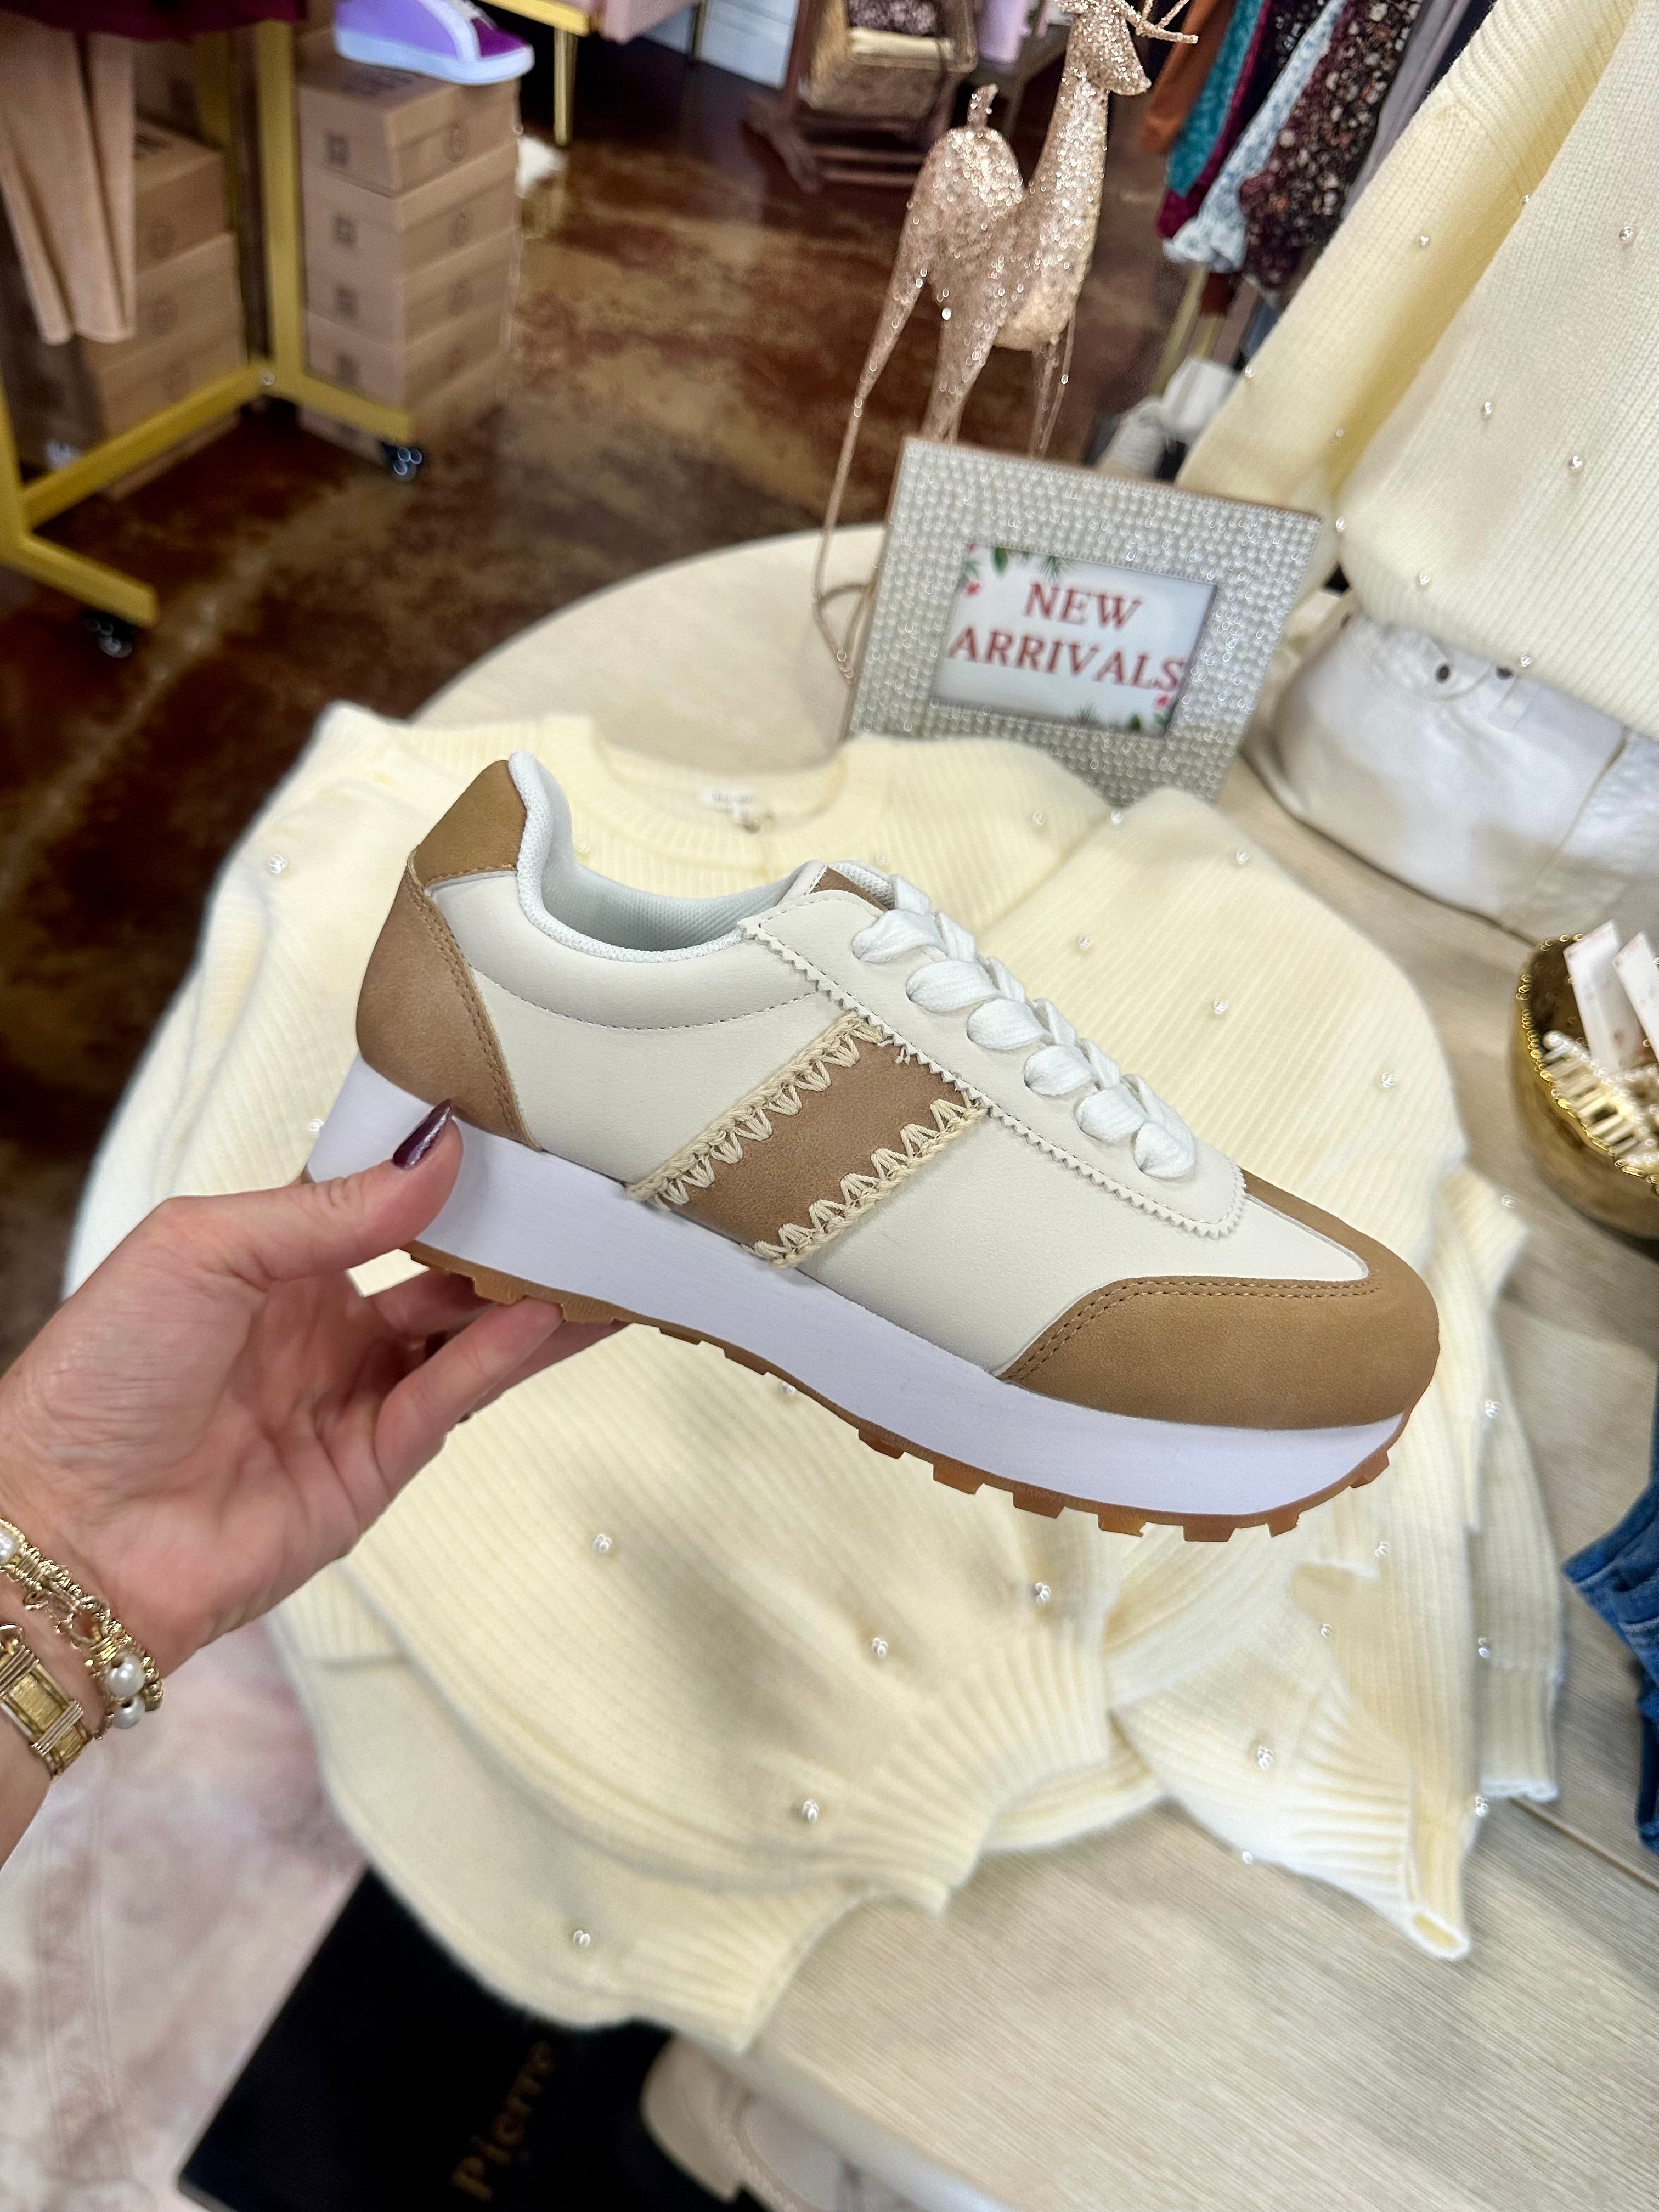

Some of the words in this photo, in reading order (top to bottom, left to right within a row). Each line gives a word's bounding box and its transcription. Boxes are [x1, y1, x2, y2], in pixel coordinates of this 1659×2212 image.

[1022, 581, 1141, 630] NEW
[948, 624, 1187, 692] ARRIVALS
[451, 2042, 551, 2202] Pierre
